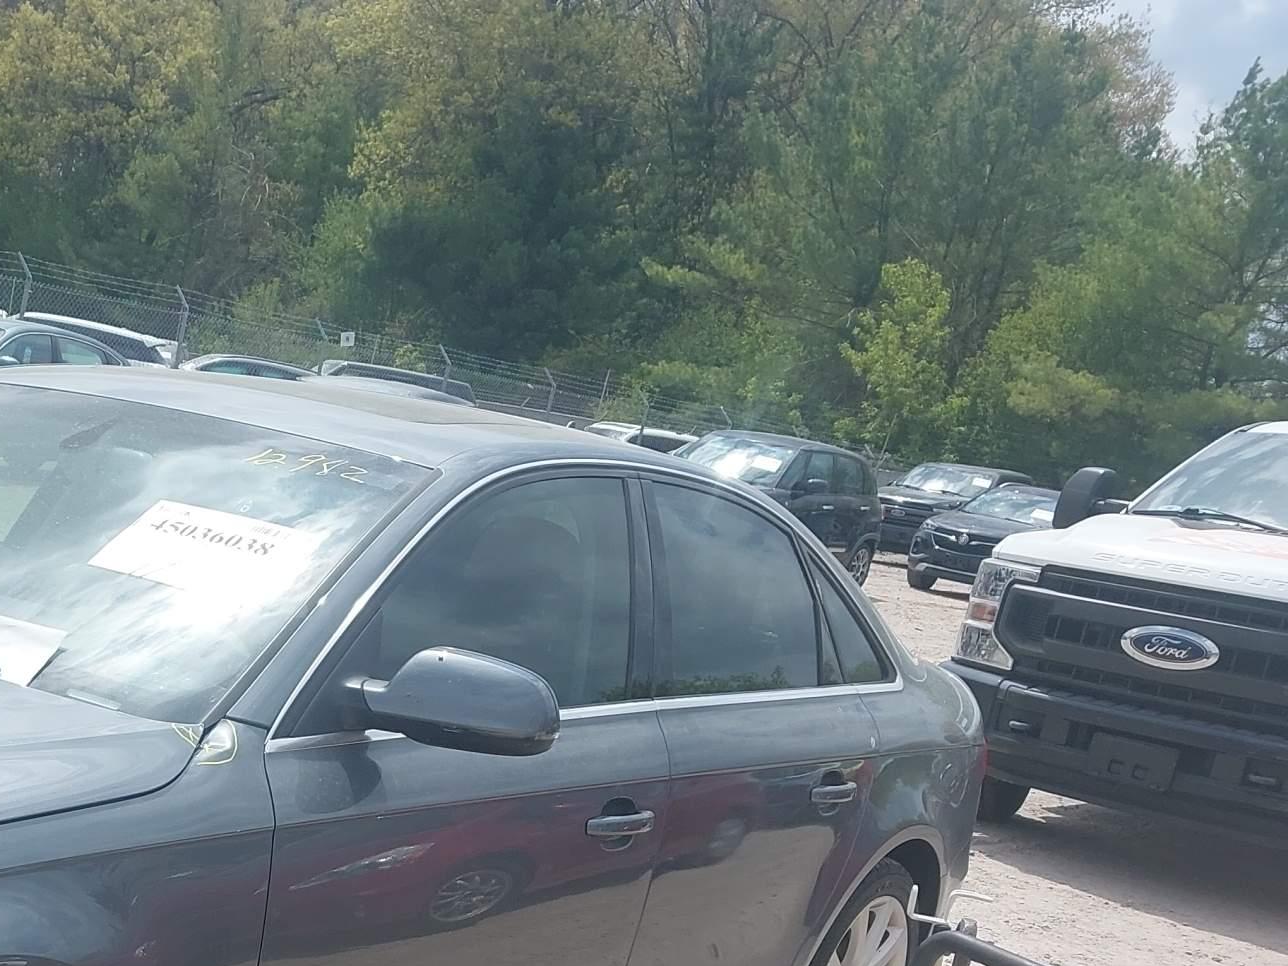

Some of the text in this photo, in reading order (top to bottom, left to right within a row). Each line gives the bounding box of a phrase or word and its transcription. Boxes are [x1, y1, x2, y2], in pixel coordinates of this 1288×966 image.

[150, 519, 275, 556] 45036038
[1091, 552, 1211, 578] SUPER
[1144, 635, 1193, 660] Ford
